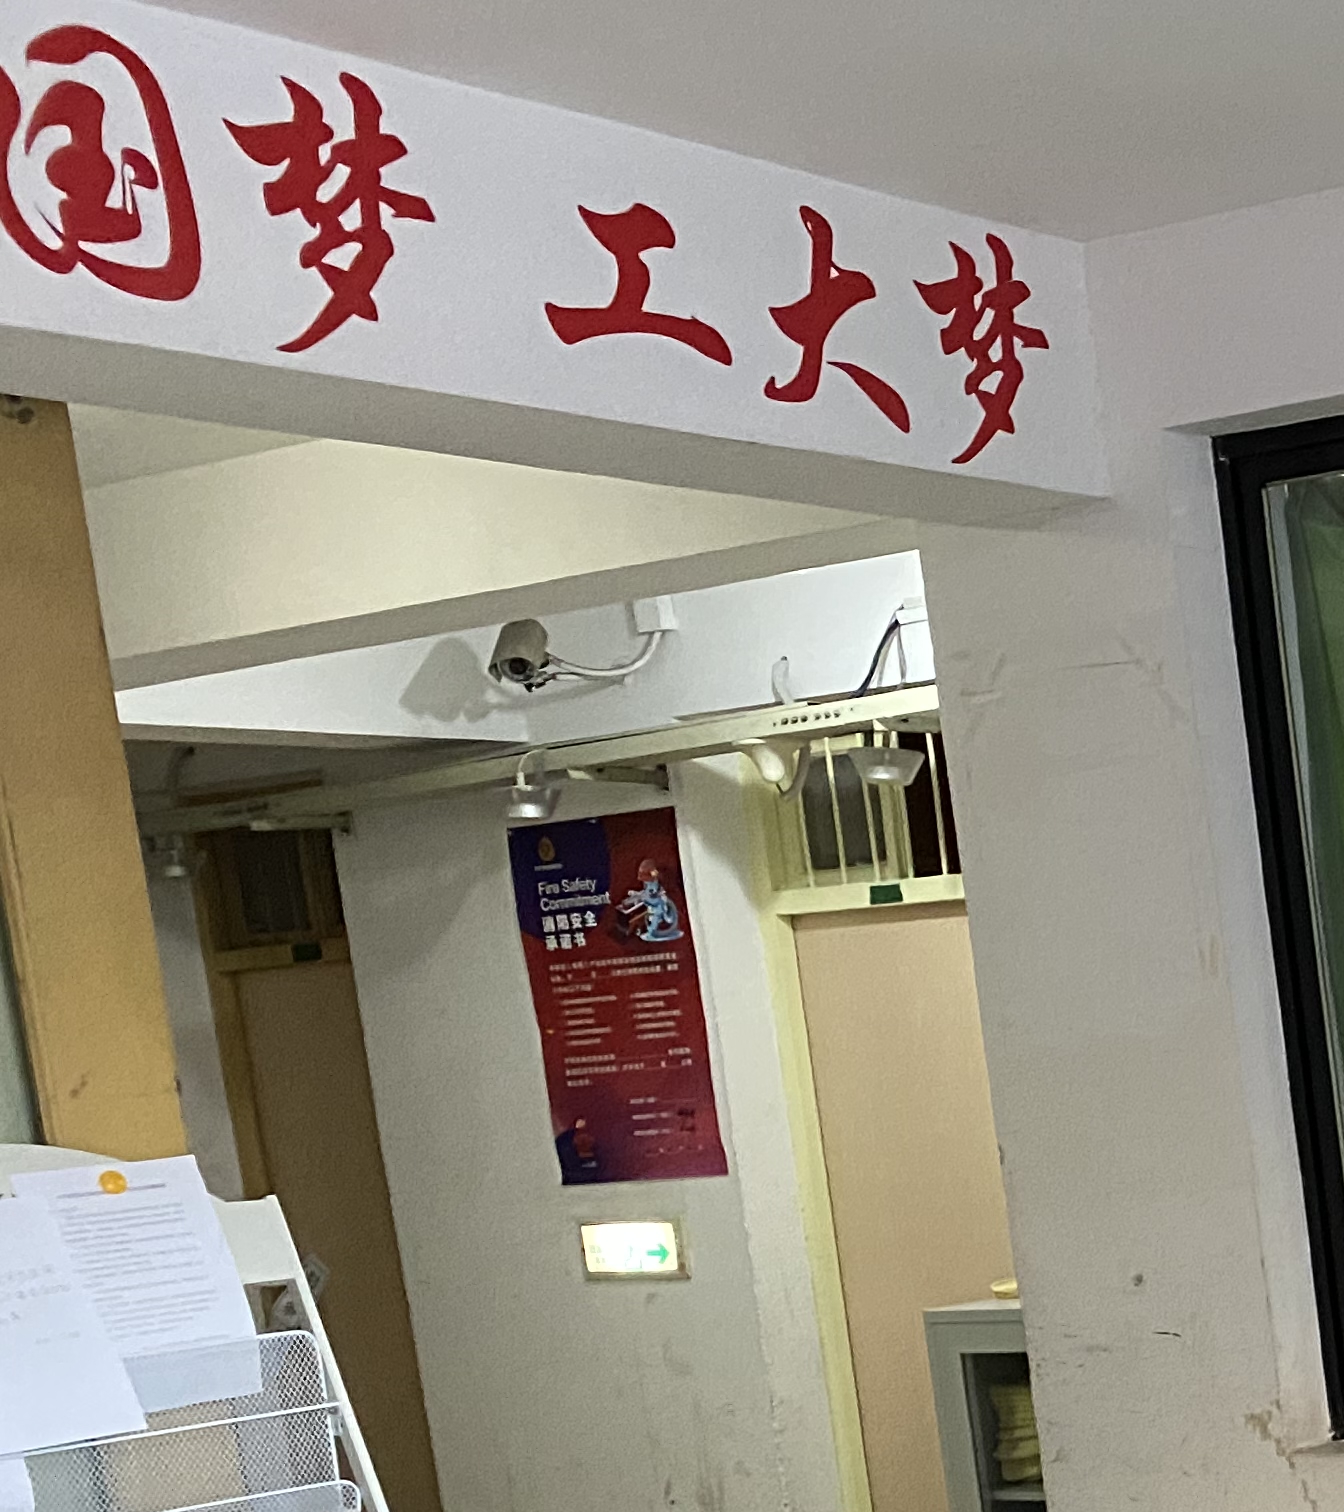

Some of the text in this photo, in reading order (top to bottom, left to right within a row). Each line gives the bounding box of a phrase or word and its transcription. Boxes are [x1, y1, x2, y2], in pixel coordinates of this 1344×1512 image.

[544, 204, 1050, 465] 工大梦
[561, 877, 597, 893] Safety
